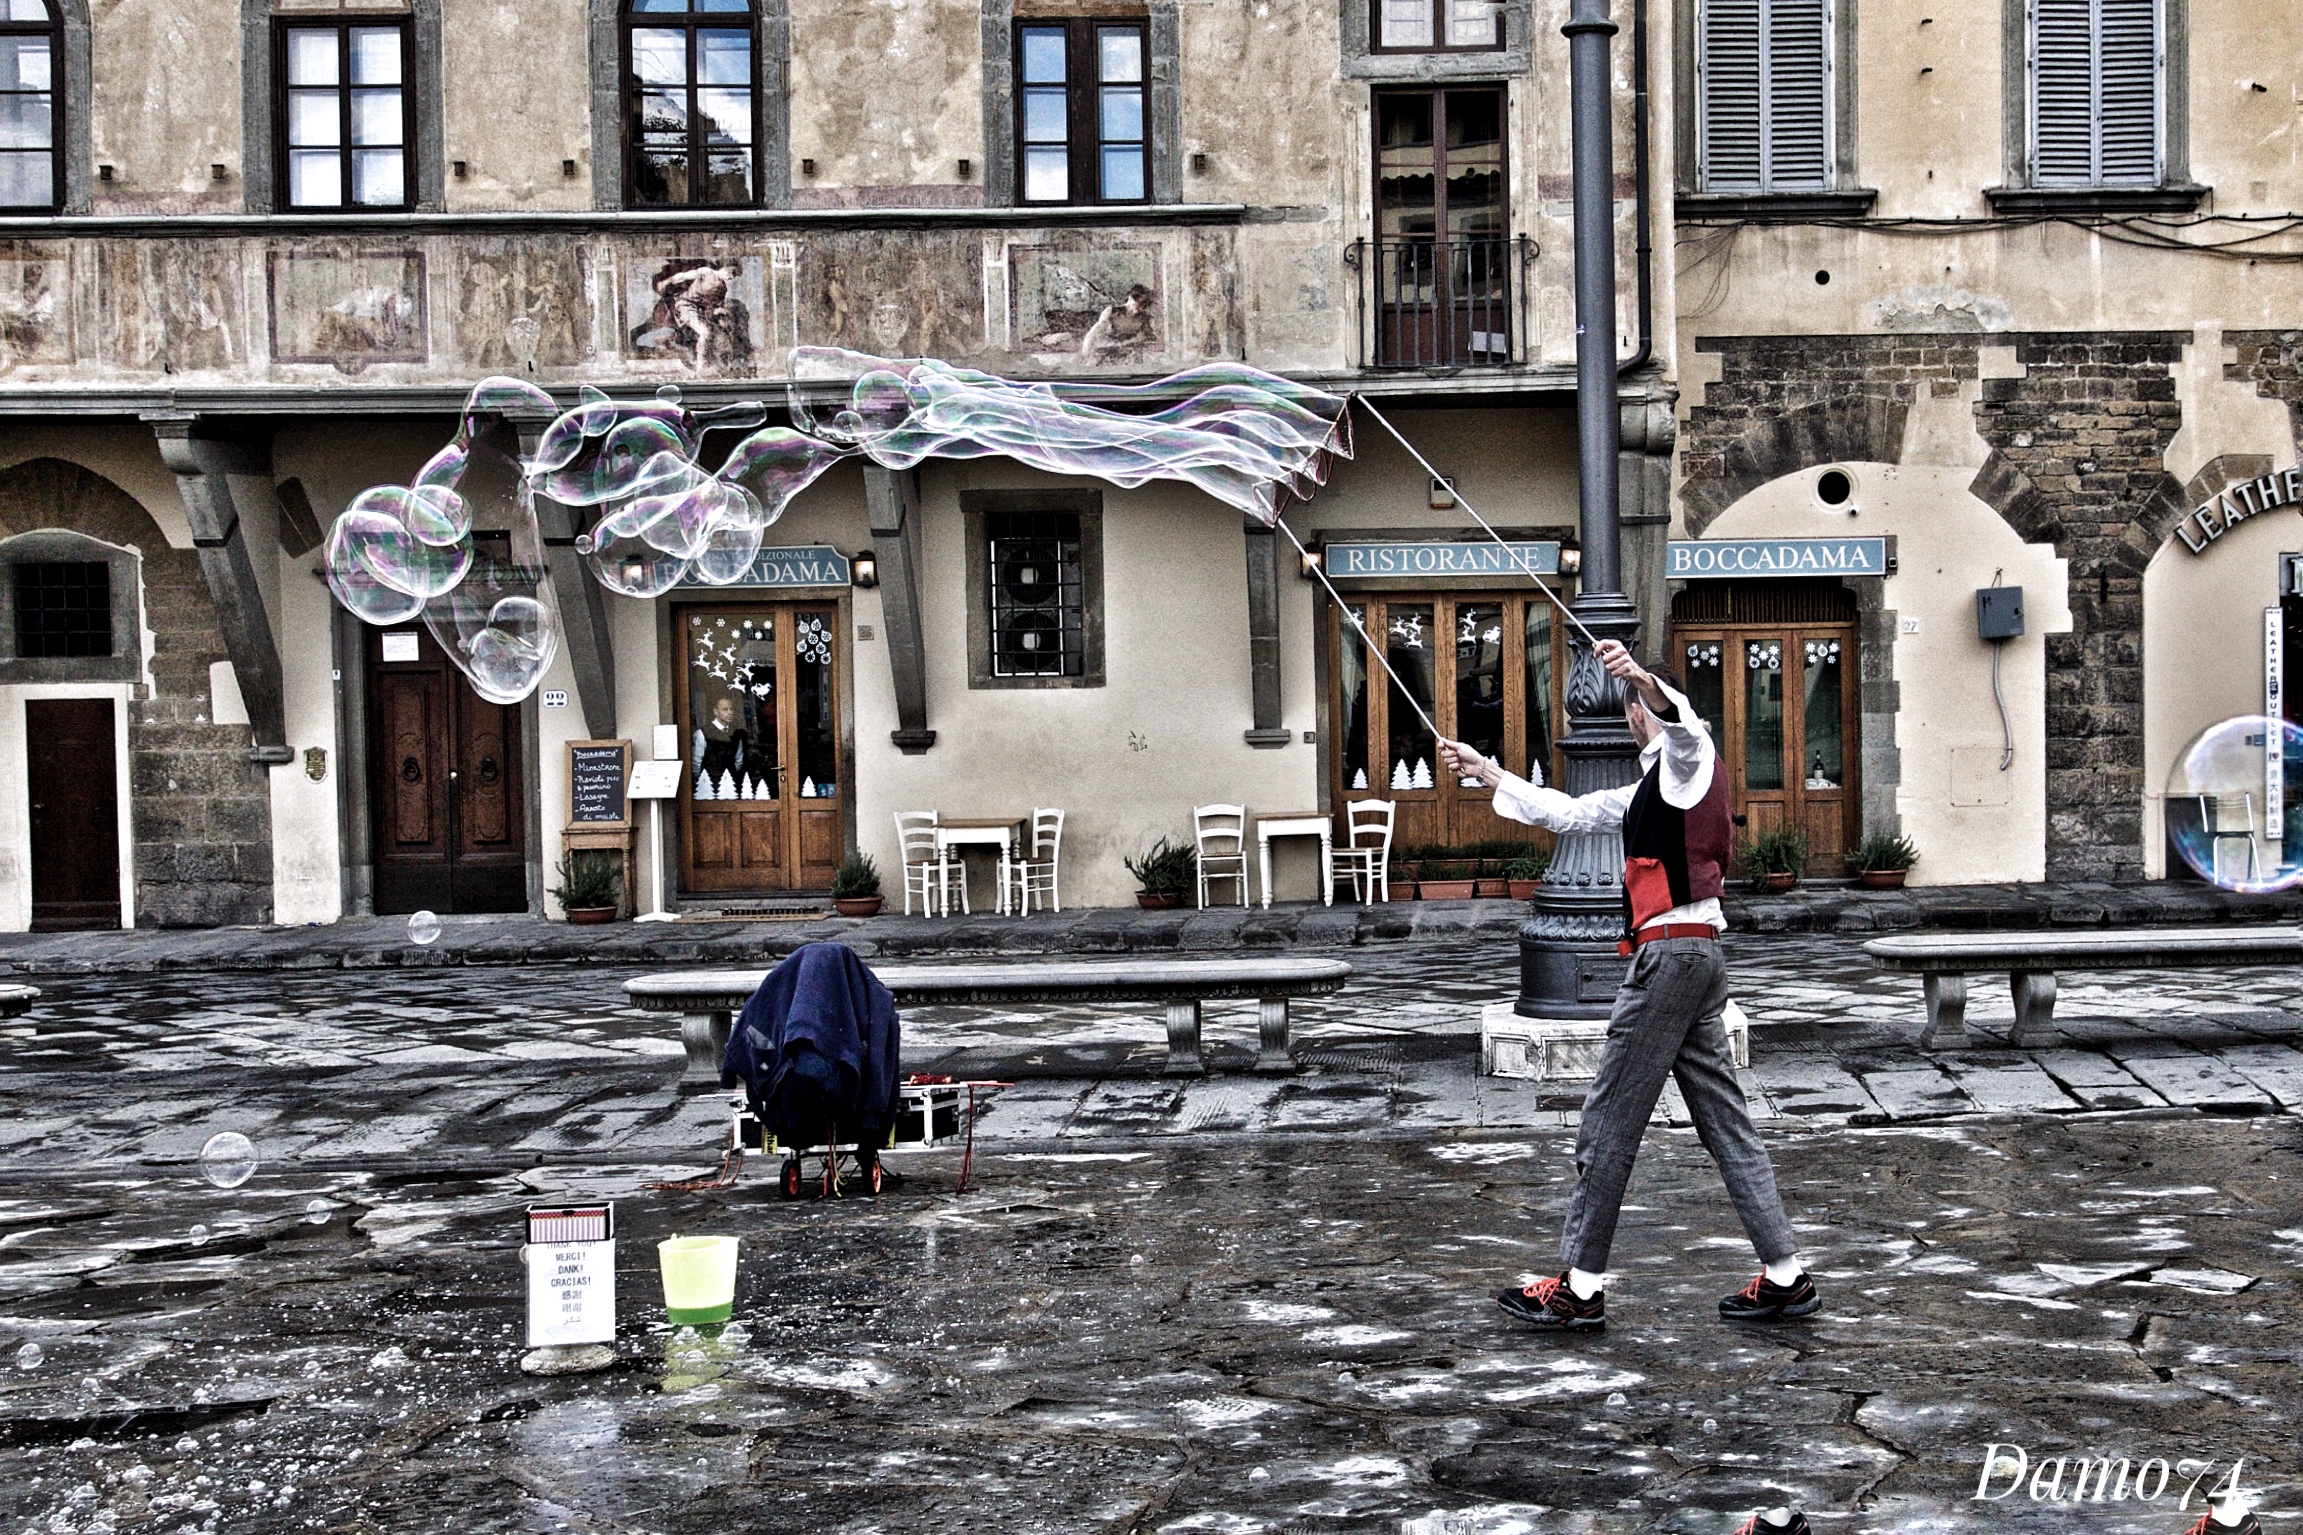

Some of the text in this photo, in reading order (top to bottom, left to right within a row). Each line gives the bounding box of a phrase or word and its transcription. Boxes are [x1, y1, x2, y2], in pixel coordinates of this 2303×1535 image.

[1348, 546, 1541, 572] RISTORANTE
[1673, 545, 1871, 571] BOCCADAMA
[1904, 621, 1917, 631] 27
[555, 1251, 586, 1261] MERCI!
[557, 1264, 584, 1274] DANK!
[551, 1276, 591, 1287] GRACIAS!
